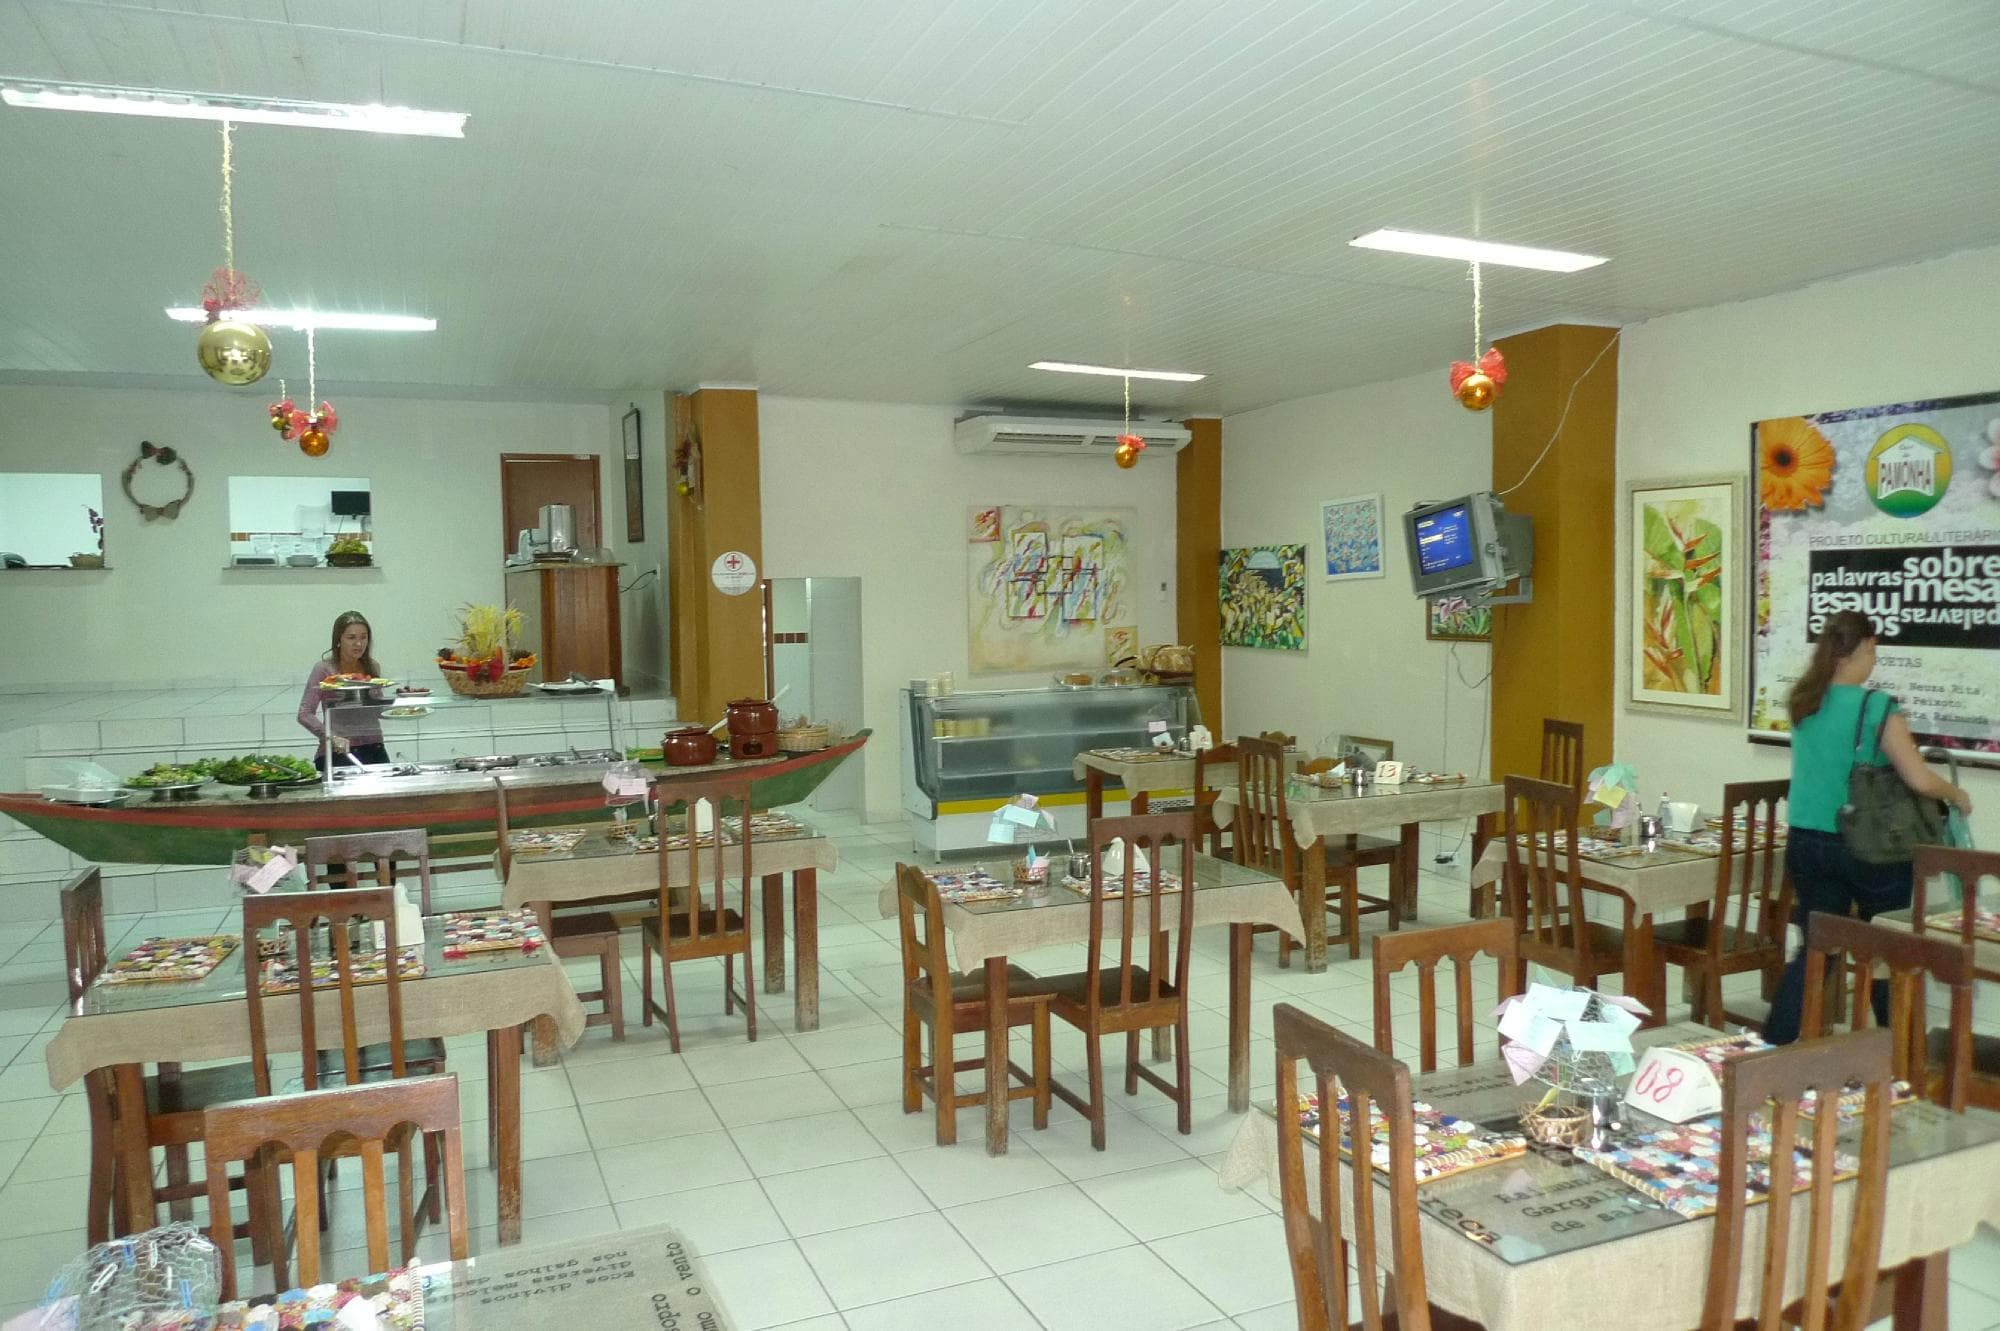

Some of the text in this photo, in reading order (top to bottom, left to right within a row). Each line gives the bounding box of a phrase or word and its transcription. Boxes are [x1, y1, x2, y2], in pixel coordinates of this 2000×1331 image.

[1809, 534, 1863, 546] PROJETO
[1903, 548, 2000, 577] sobre
[1811, 566, 1902, 591] palavras
[1903, 578, 2000, 602] mesa
[1810, 592, 1900, 615] mesa
[1901, 604, 2000, 631] palavras
[1551, 1219, 1586, 1232] de
[505, 1258, 579, 1279] galhos
[532, 1260, 632, 1284] diversas
[666, 1242, 694, 1280] vento
[481, 1270, 635, 1304] Ecos divinos
[686, 1287, 701, 1296] o
